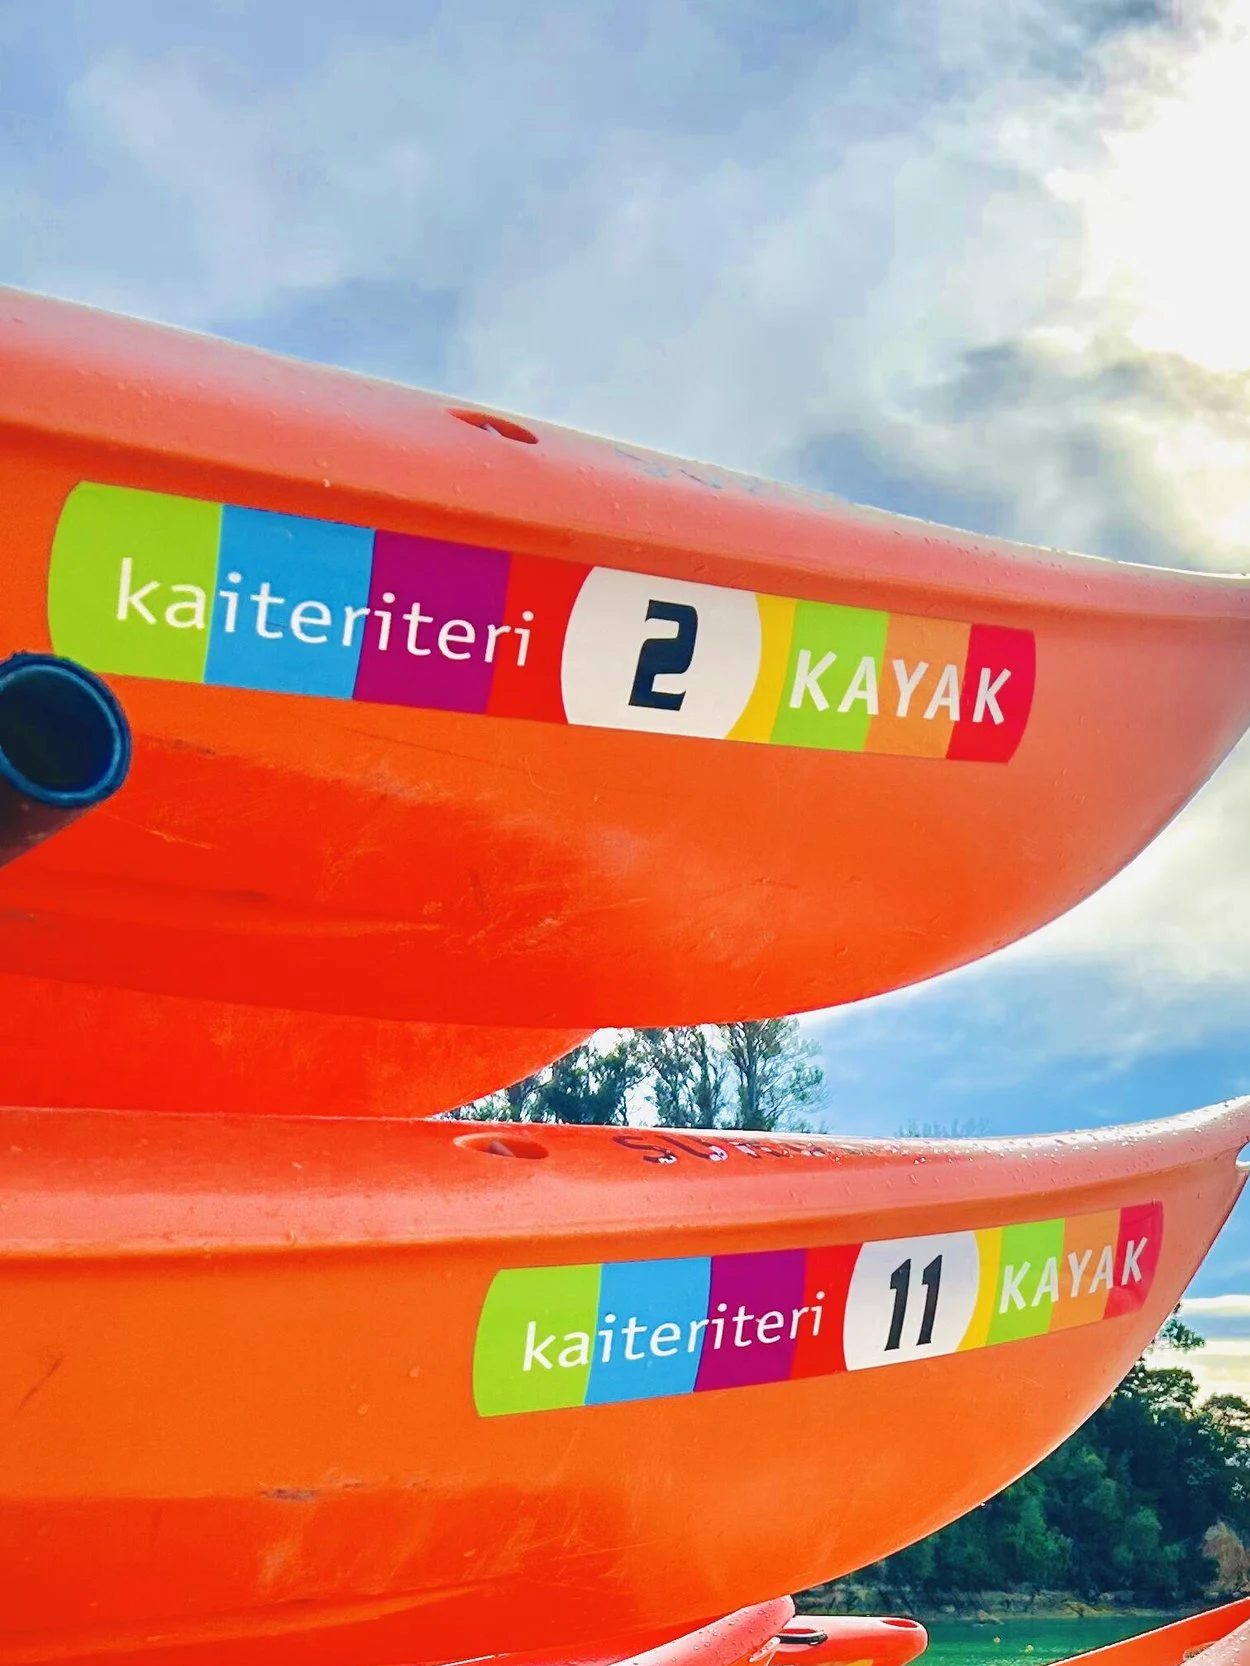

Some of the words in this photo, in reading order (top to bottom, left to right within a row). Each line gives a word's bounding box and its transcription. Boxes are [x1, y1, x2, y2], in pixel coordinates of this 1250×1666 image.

[116, 557, 532, 667] kaiteriteri
[627, 600, 699, 712] 2
[788, 648, 1011, 726] KAYAK
[522, 1290, 825, 1372] kaiteriteri
[884, 1253, 944, 1352] 11
[999, 1236, 1148, 1314] KAYAK
